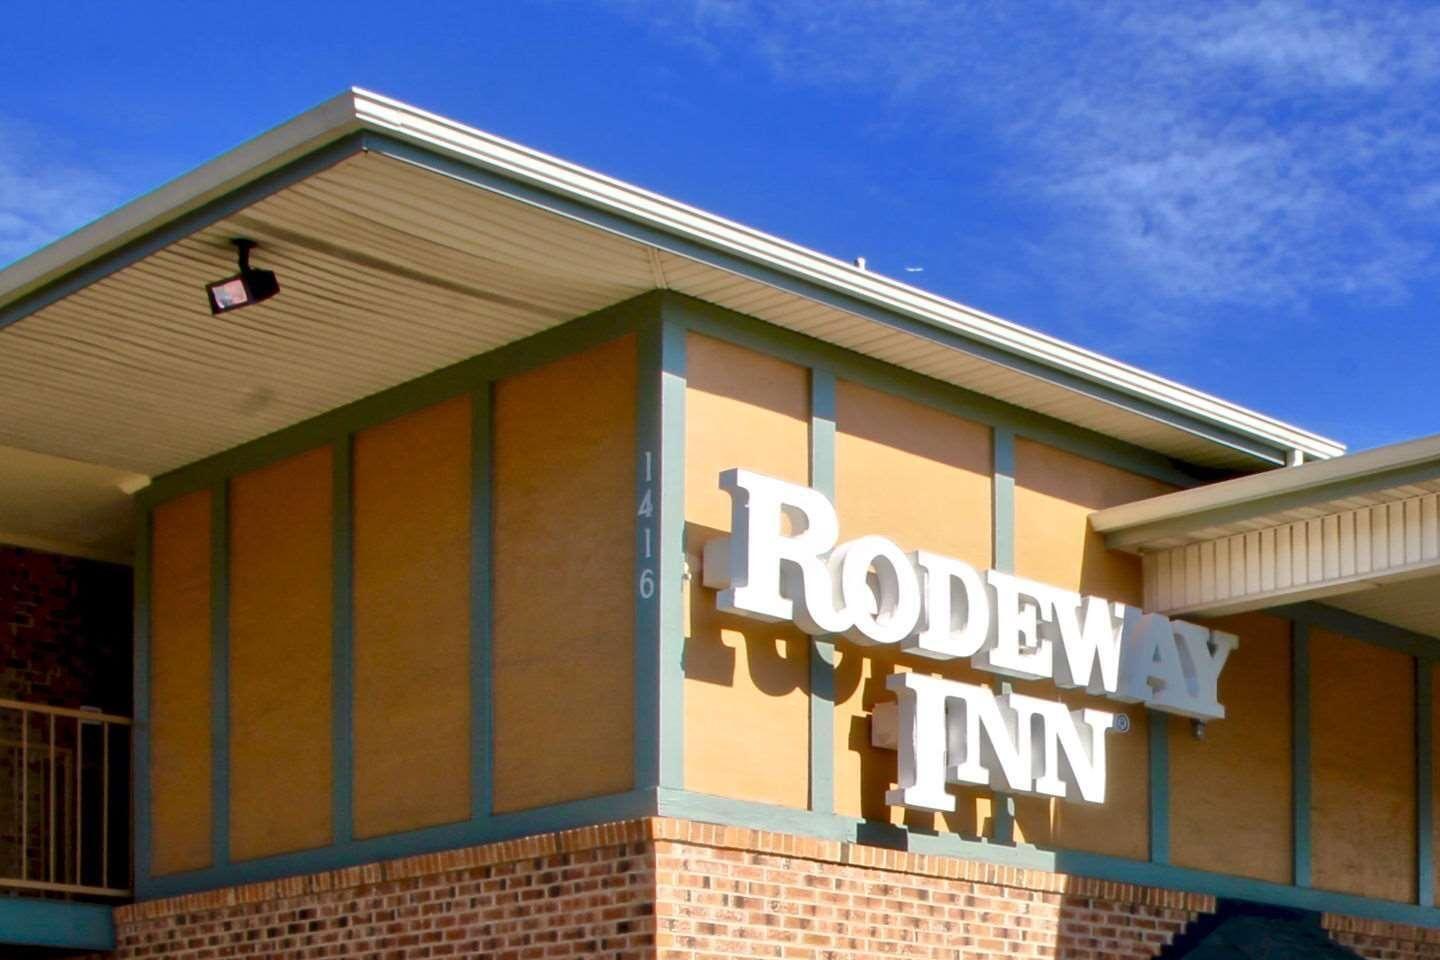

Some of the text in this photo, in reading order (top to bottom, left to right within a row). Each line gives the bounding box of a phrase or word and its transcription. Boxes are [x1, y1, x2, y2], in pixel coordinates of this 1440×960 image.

[637, 451, 655, 599] 1416
[719, 468, 1239, 719] RODEWAY
[886, 672, 1114, 813] INN
